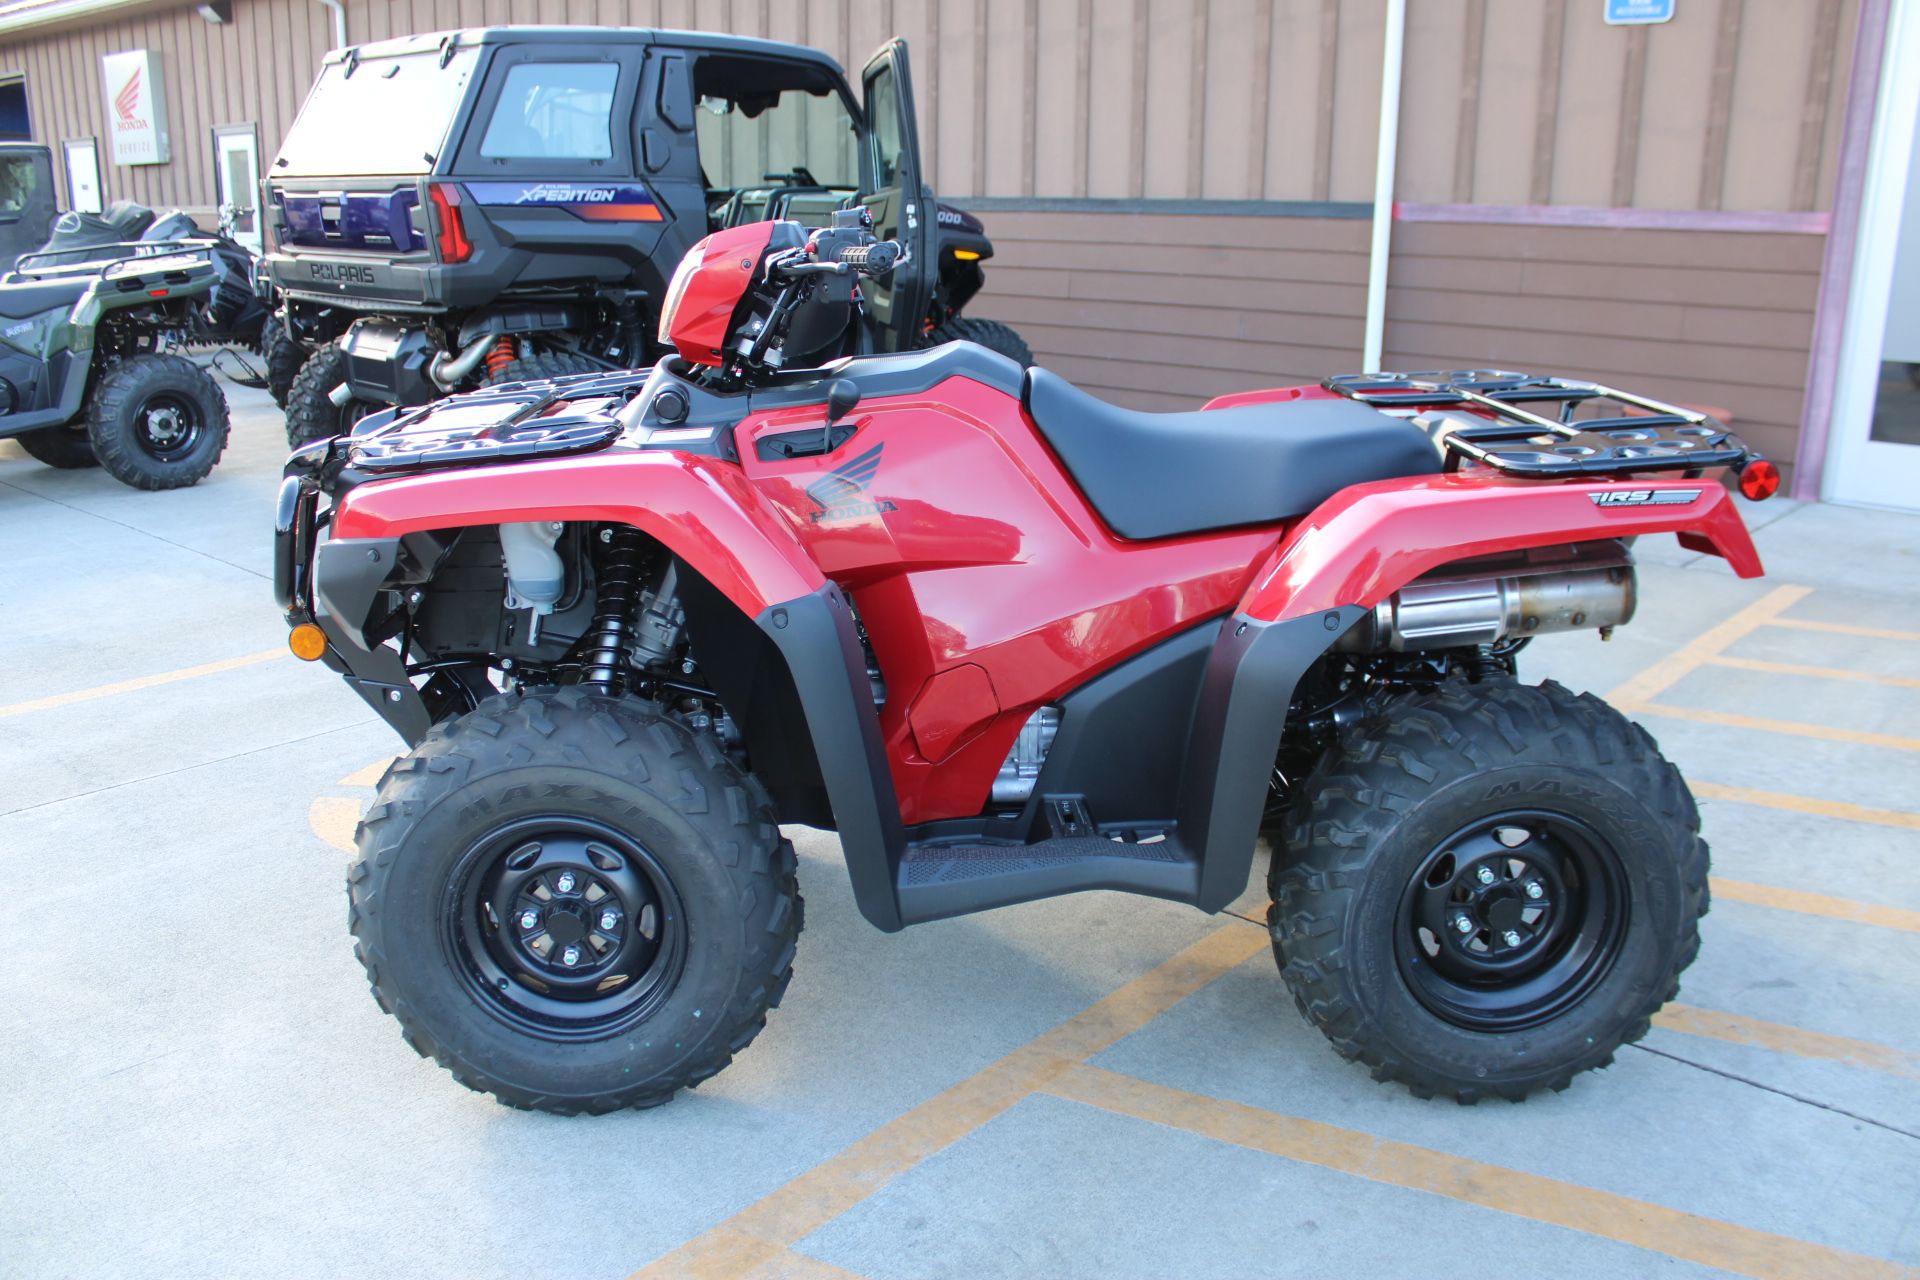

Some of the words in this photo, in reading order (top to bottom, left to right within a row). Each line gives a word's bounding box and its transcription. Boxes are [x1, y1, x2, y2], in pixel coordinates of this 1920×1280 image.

[515, 184, 616, 205] XPEDITION
[310, 263, 375, 283] POLARIS
[1600, 490, 1652, 502] IRS
[809, 501, 899, 524] HONDA
